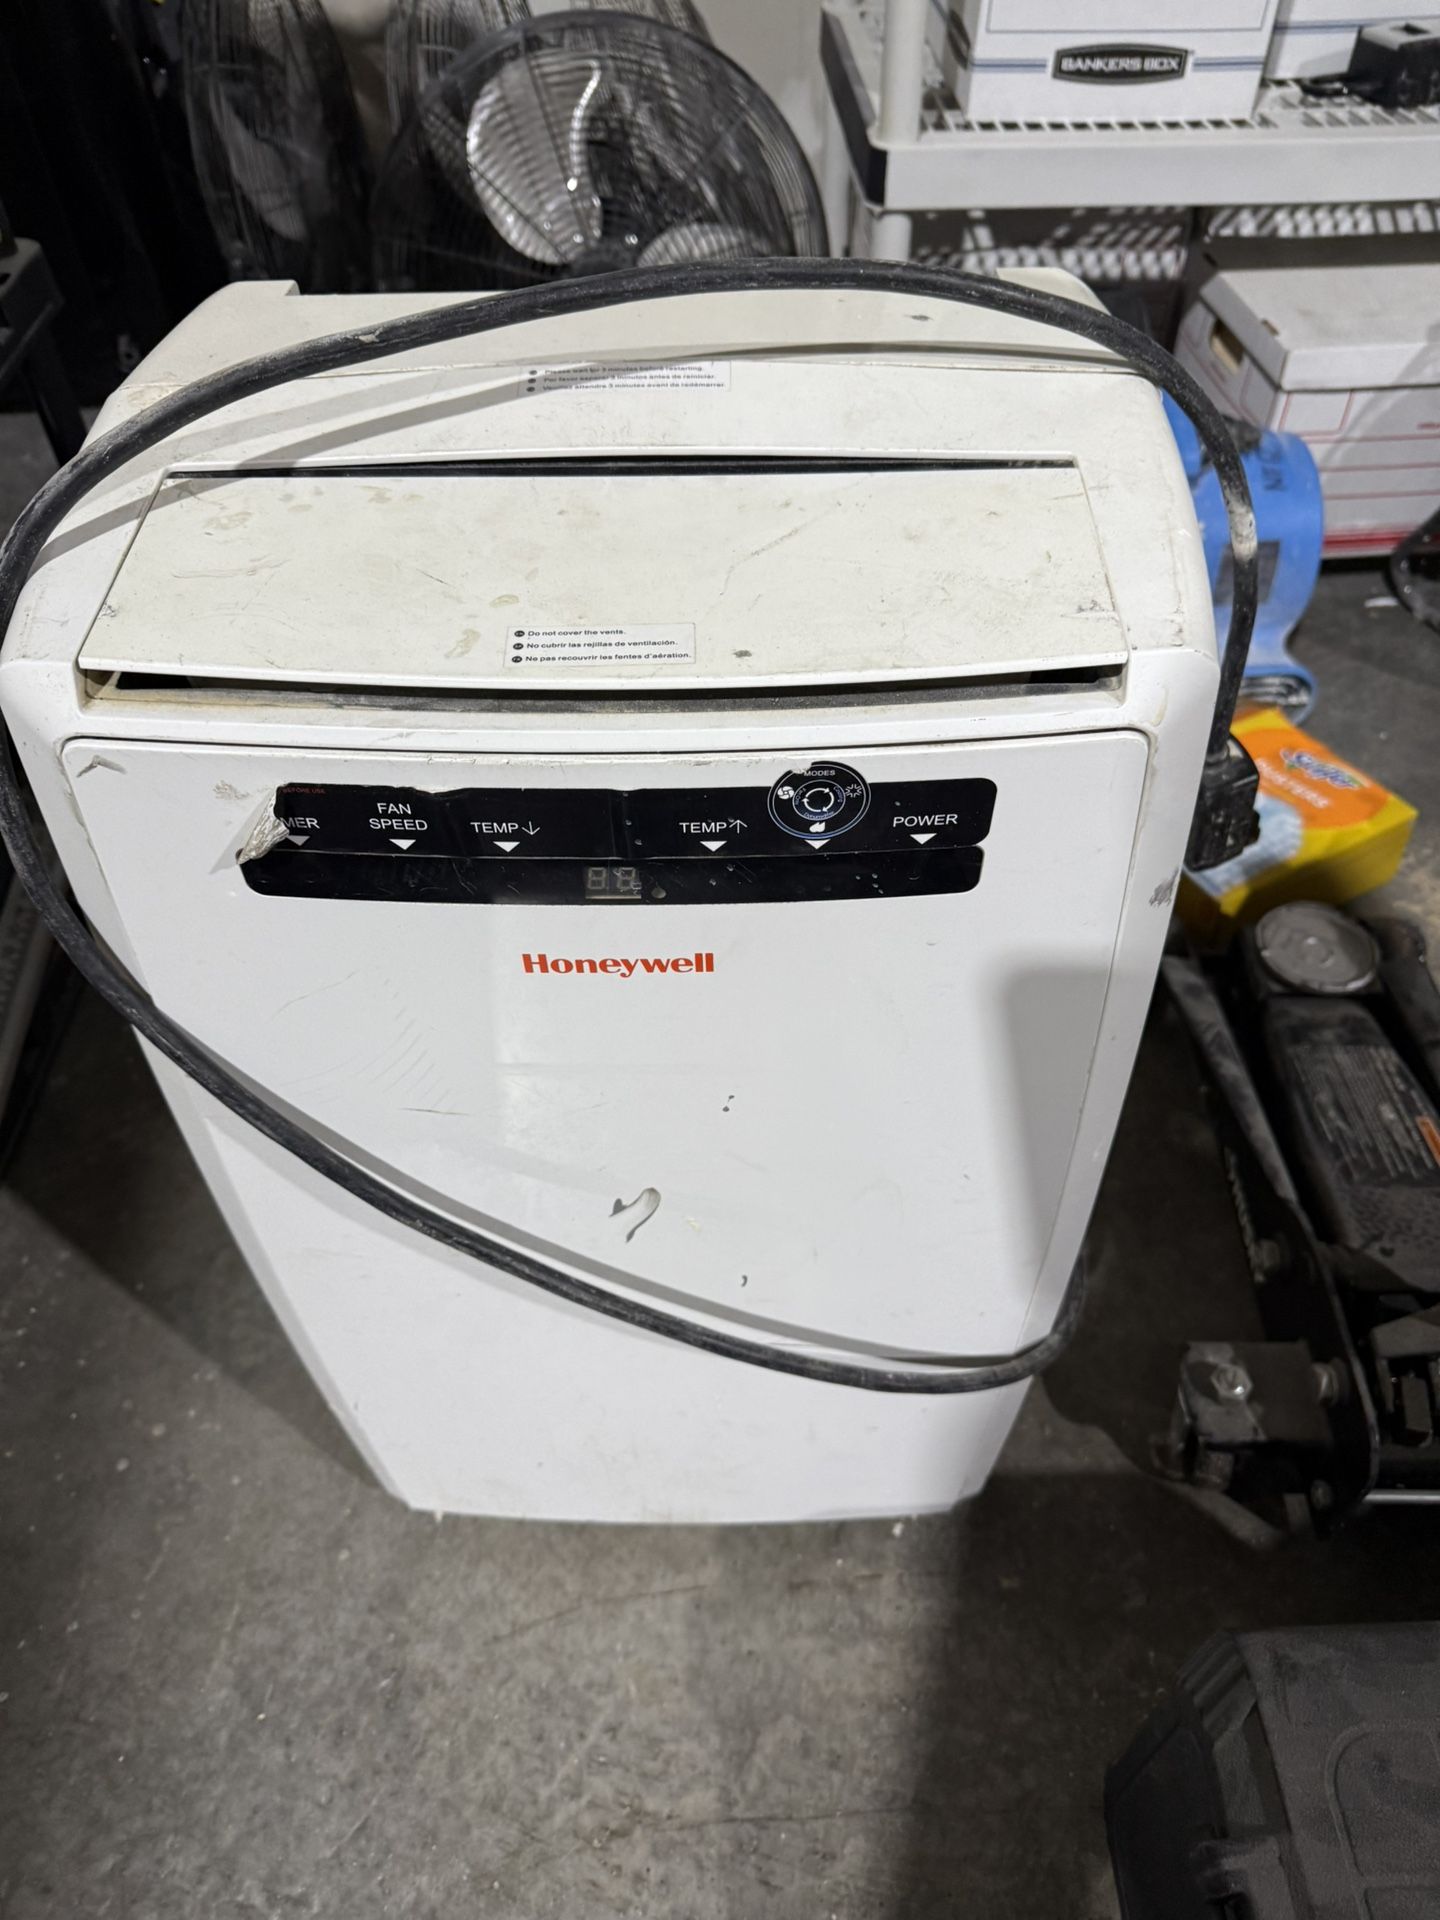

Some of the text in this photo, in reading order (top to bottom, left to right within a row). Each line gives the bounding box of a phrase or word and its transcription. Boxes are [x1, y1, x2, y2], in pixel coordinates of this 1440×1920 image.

[1060, 56, 1180, 72] BANKERS BOX
[583, 641, 613, 649] rejillas
[803, 769, 836, 777] MODES
[376, 802, 412, 815] FAN
[280, 817, 320, 830] MER
[369, 818, 428, 831] SPEED
[892, 813, 958, 828] POWER
[470, 822, 519, 834] TEMP
[679, 821, 728, 834] TEMP
[521, 952, 715, 978] Honeywell
